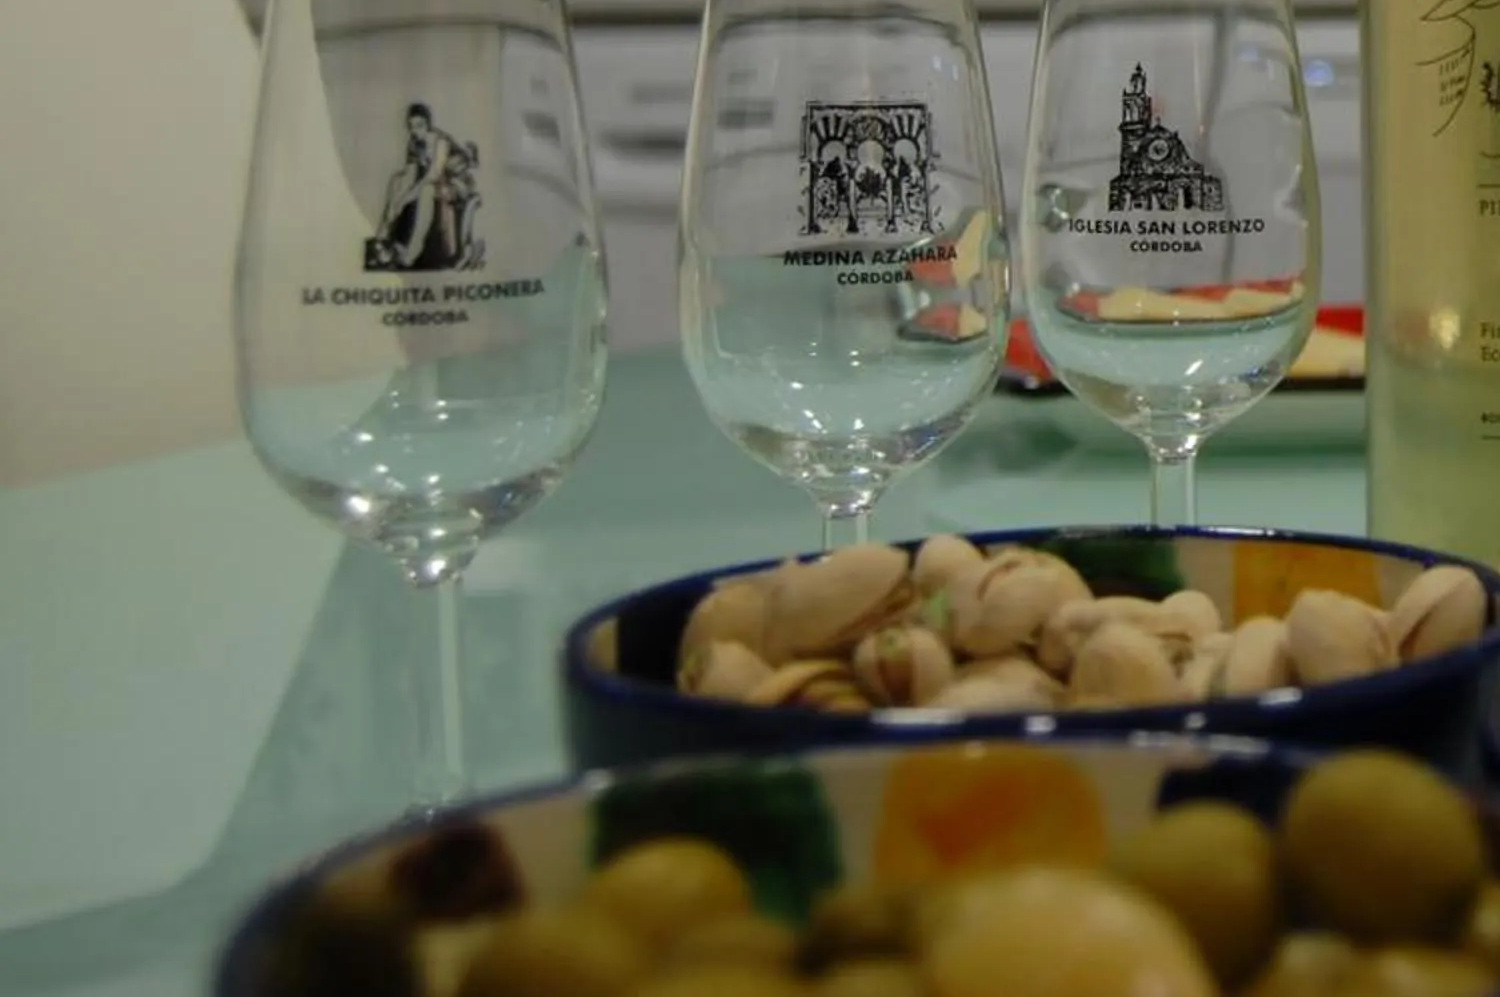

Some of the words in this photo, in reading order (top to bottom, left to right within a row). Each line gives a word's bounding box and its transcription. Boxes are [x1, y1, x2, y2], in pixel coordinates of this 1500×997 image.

[1069, 218, 1132, 234] IGLESIA
[1137, 220, 1175, 234] SAN
[1182, 218, 1265, 234] LORENZO
[784, 250, 864, 266] MEDINA
[871, 245, 957, 265] AZAHARA
[302, 287, 325, 305] LA
[331, 286, 436, 305] CHIQUITA
[442, 279, 545, 302] PICONERA
